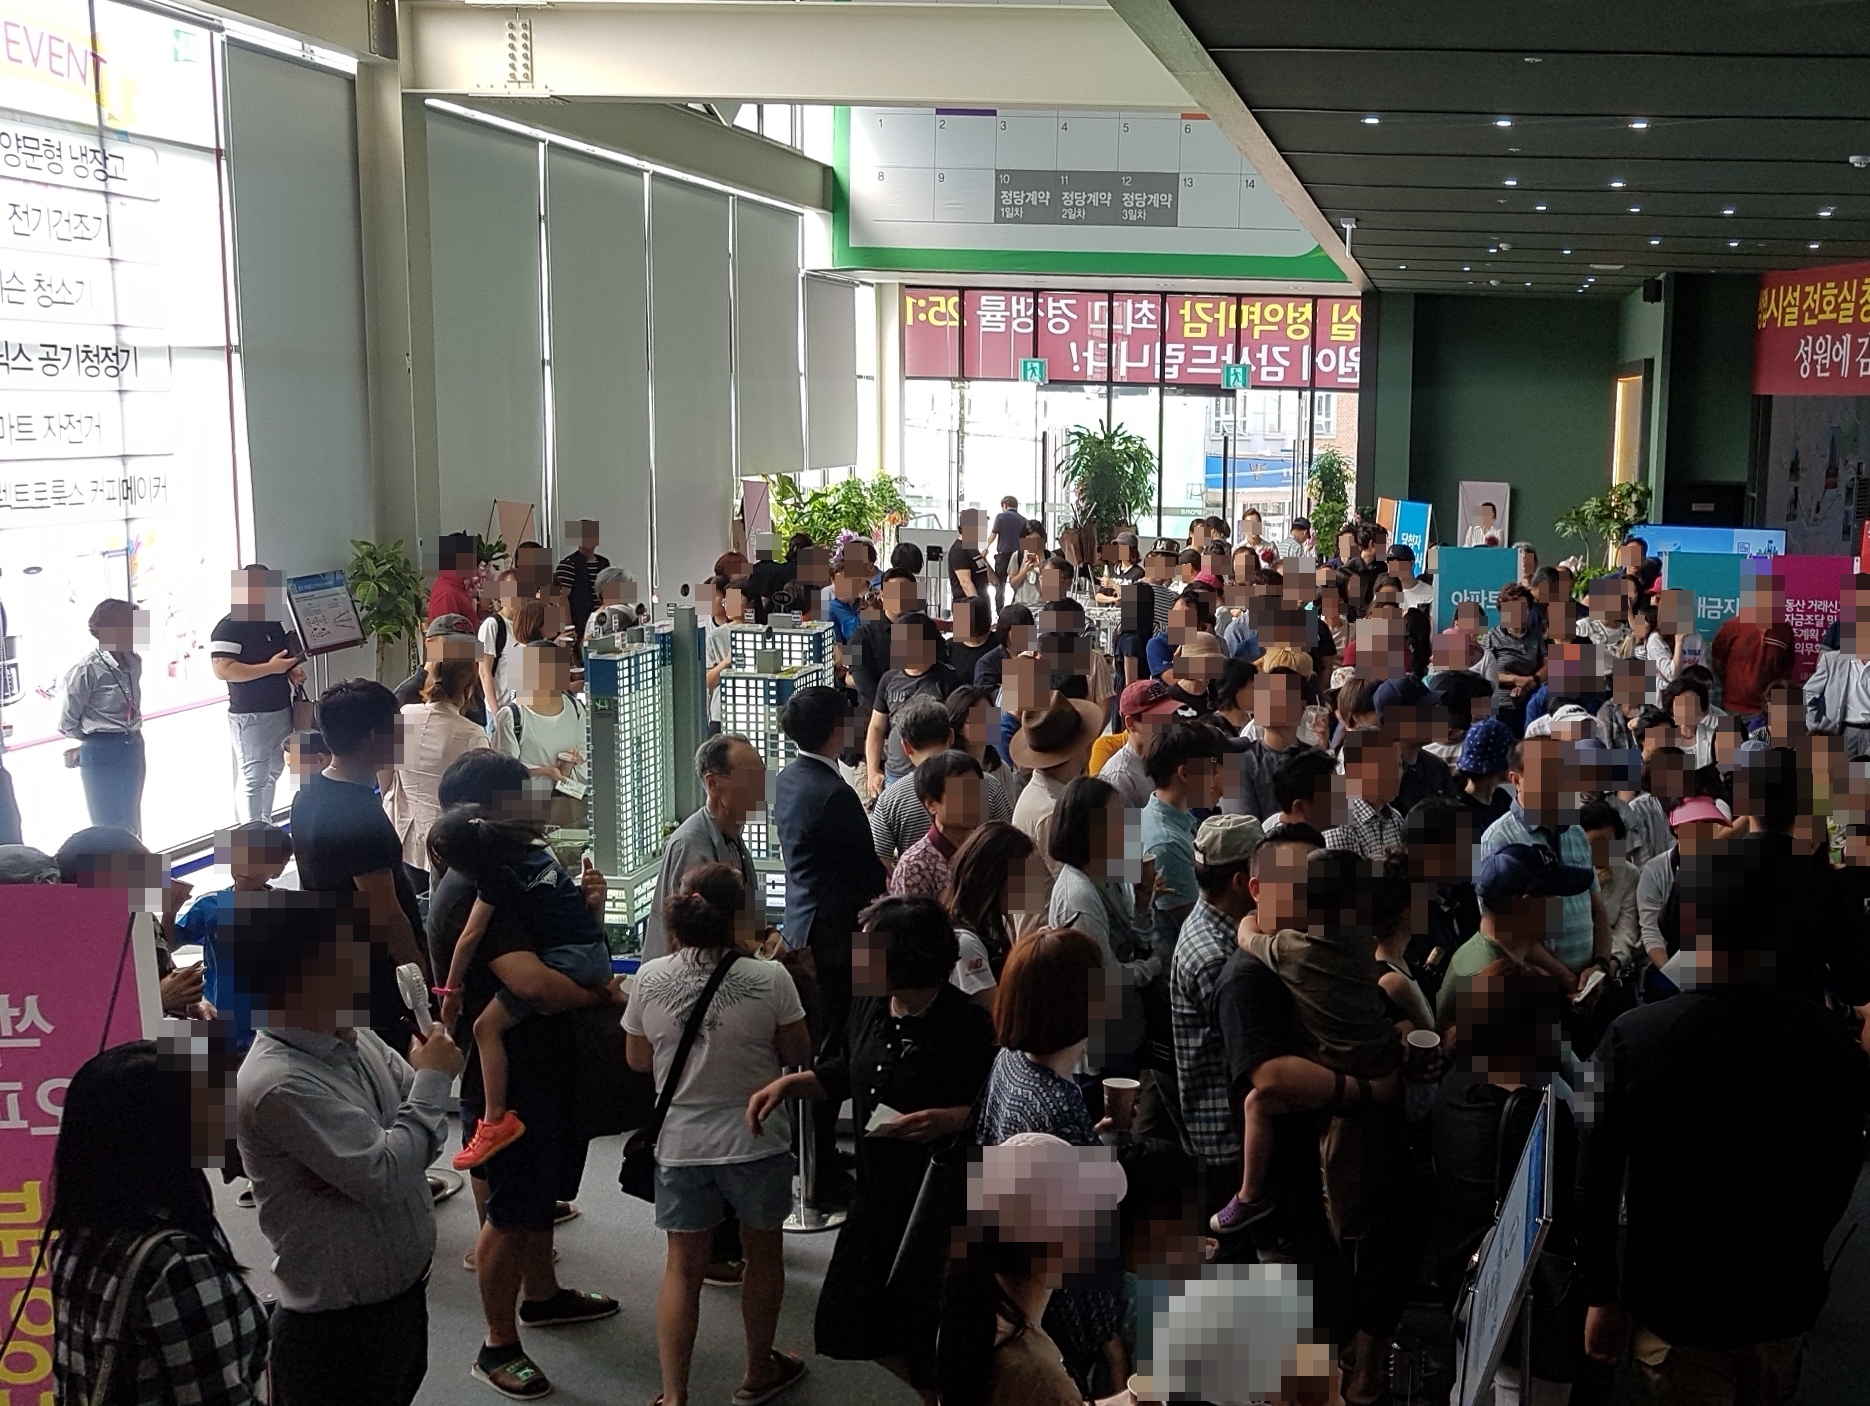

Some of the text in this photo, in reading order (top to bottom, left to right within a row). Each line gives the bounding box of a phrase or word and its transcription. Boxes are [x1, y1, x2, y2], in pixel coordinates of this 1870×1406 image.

[3, 20, 107, 86] EVENT
[878, 118, 884, 128] 1
[939, 119, 946, 130] 2
[1000, 120, 1007, 131] 3
[1061, 122, 1068, 132] 4
[1122, 123, 1130, 133] 5
[1184, 123, 1191, 134] 6
[0, 131, 128, 182] 양문형 냉장고
[877, 171, 885, 182] 8
[938, 172, 945, 183] 9
[999, 173, 1010, 184] 10
[1060, 175, 1069, 185] 11
[1121, 176, 1132, 187] 12
[1183, 177, 1193, 188] 13
[1244, 179, 1256, 190] 14
[1000, 190, 1050, 206] 정당계약
[1061, 191, 1112, 207] 정당계약
[1121, 192, 1173, 208] 정당계약
[1000, 207, 1023, 219] 1일차
[1061, 208, 1086, 220] 2일차
[1122, 209, 1146, 221] 3일차
[8, 202, 112, 247] 전기건조기
[0, 271, 92, 309] 슨 청소기
[38, 343, 138, 378] 공기청정기
[1794, 333, 1851, 379] 성원에
[43, 413, 102, 445] 자전거
[91, 473, 168, 508] 커피메이커
[1807, 599, 1840, 614] 거래신
